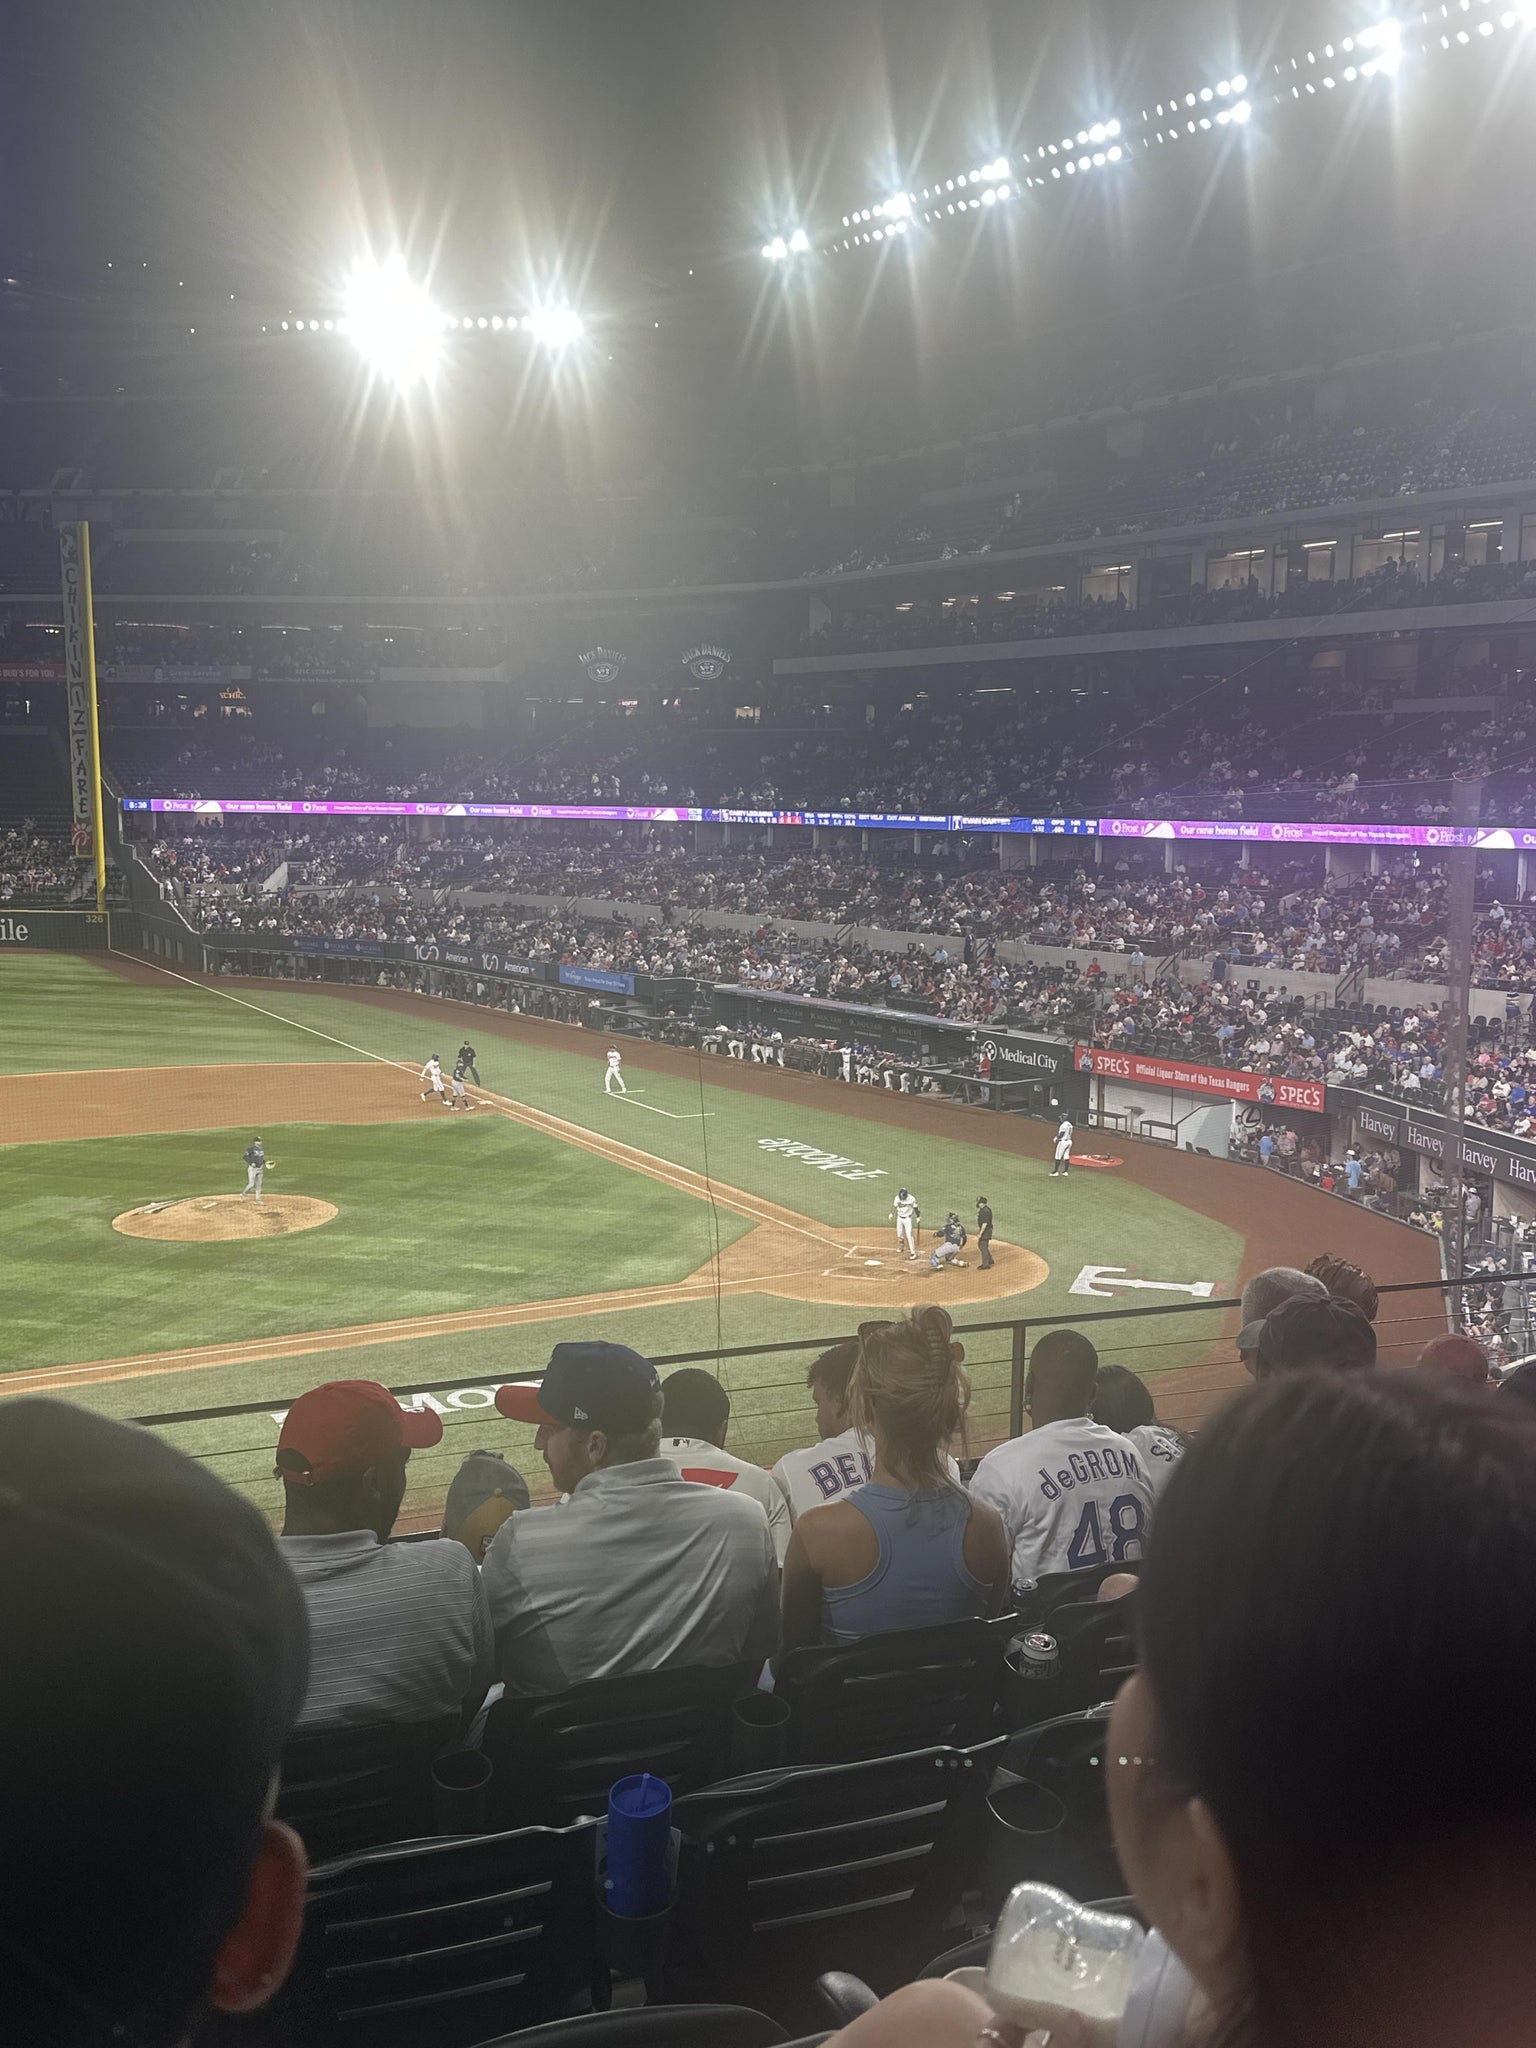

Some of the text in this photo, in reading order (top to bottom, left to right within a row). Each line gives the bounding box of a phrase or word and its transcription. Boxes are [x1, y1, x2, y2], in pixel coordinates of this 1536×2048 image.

[64, 567, 83, 679] CHIKIN
[71, 685, 87, 725] IZ
[74, 739, 89, 815] FARE
[1121, 824, 1139, 833] Frost
[1180, 825, 1259, 836] Our new home field
[1284, 828, 1303, 838] Frost
[1440, 832, 1463, 842] Frost
[0, 918, 29, 941] ile
[85, 915, 103, 923] 326
[446, 952, 469, 964] American
[504, 961, 530, 974] American
[999, 1046, 1058, 1073] Medical City
[1097, 1055, 1131, 1075] SPEC'S
[1136, 1063, 1155, 1077] Official
[1156, 1067, 1174, 1080] Liquor
[1174, 1070, 1190, 1083] Store
[1198, 1073, 1207, 1085] the
[1208, 1075, 1225, 1087] Texas
[1226, 1078, 1250, 1092] Rangers
[1280, 1085, 1321, 1106] SPEC'S
[1360, 1111, 1395, 1141] Harvey
[1407, 1126, 1445, 1157] Harvey
[1037, 1447, 1142, 1501] deGROM
[1066, 1494, 1147, 1570] 48
